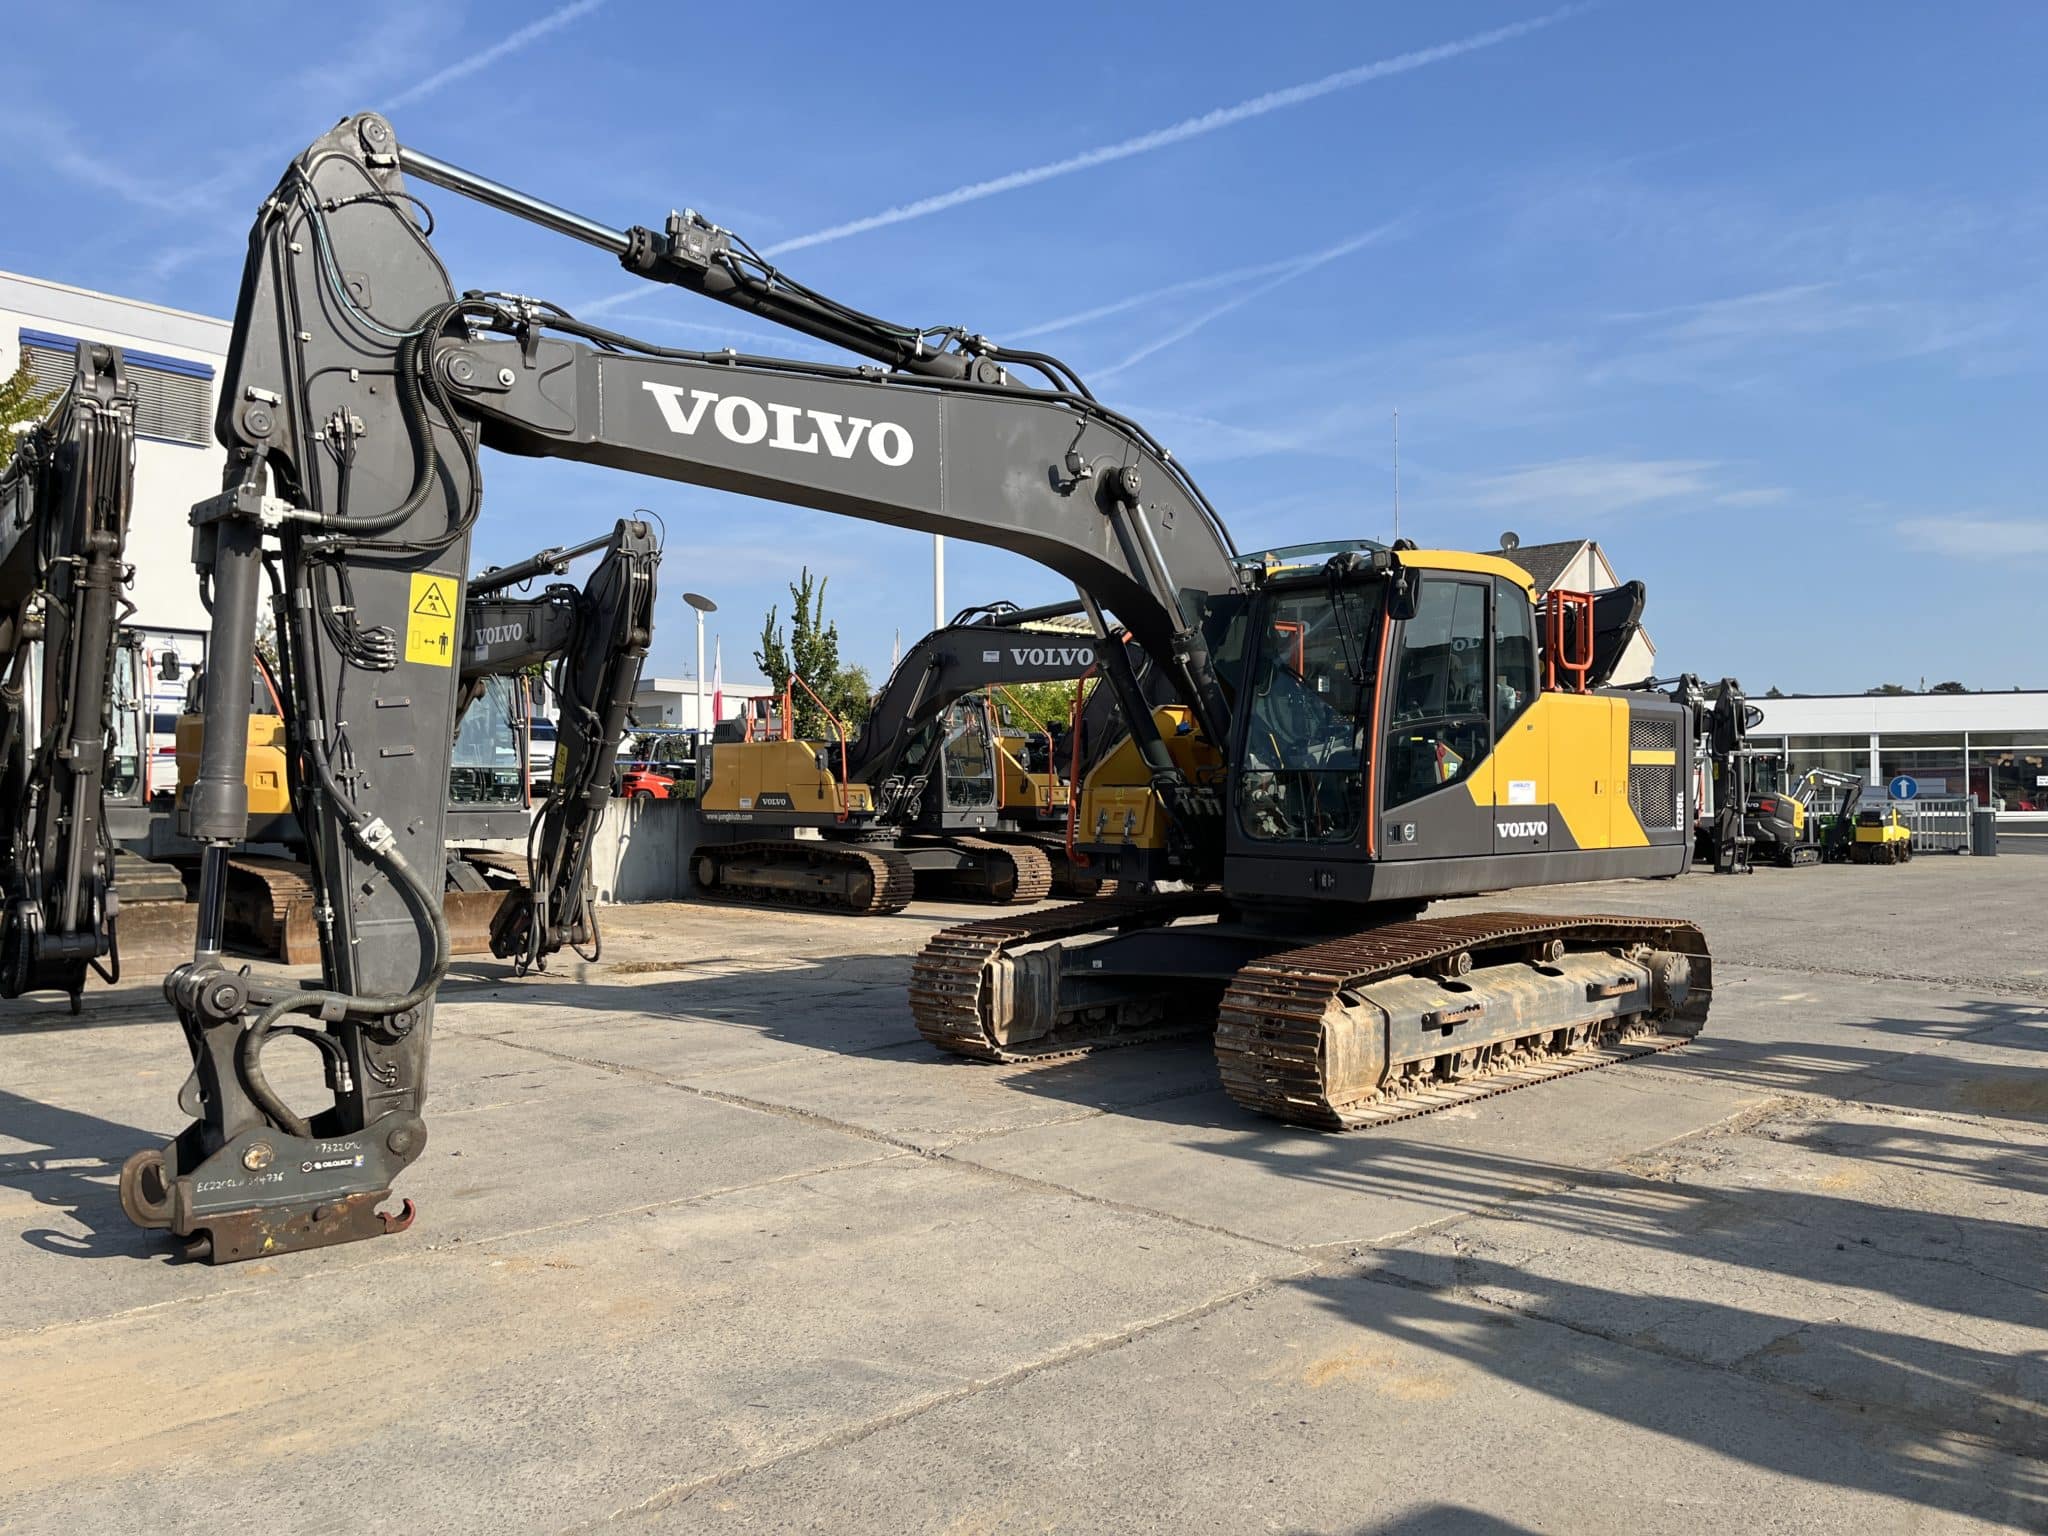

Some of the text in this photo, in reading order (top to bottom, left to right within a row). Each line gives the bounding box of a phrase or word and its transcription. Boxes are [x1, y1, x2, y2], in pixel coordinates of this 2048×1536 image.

[641, 381, 914, 467] VOLVO
[476, 623, 522, 645] VOLVO
[1010, 648, 1094, 666] VOLVO
[762, 798, 786, 806] VOLVO
[1497, 821, 1548, 838] VOLVO
